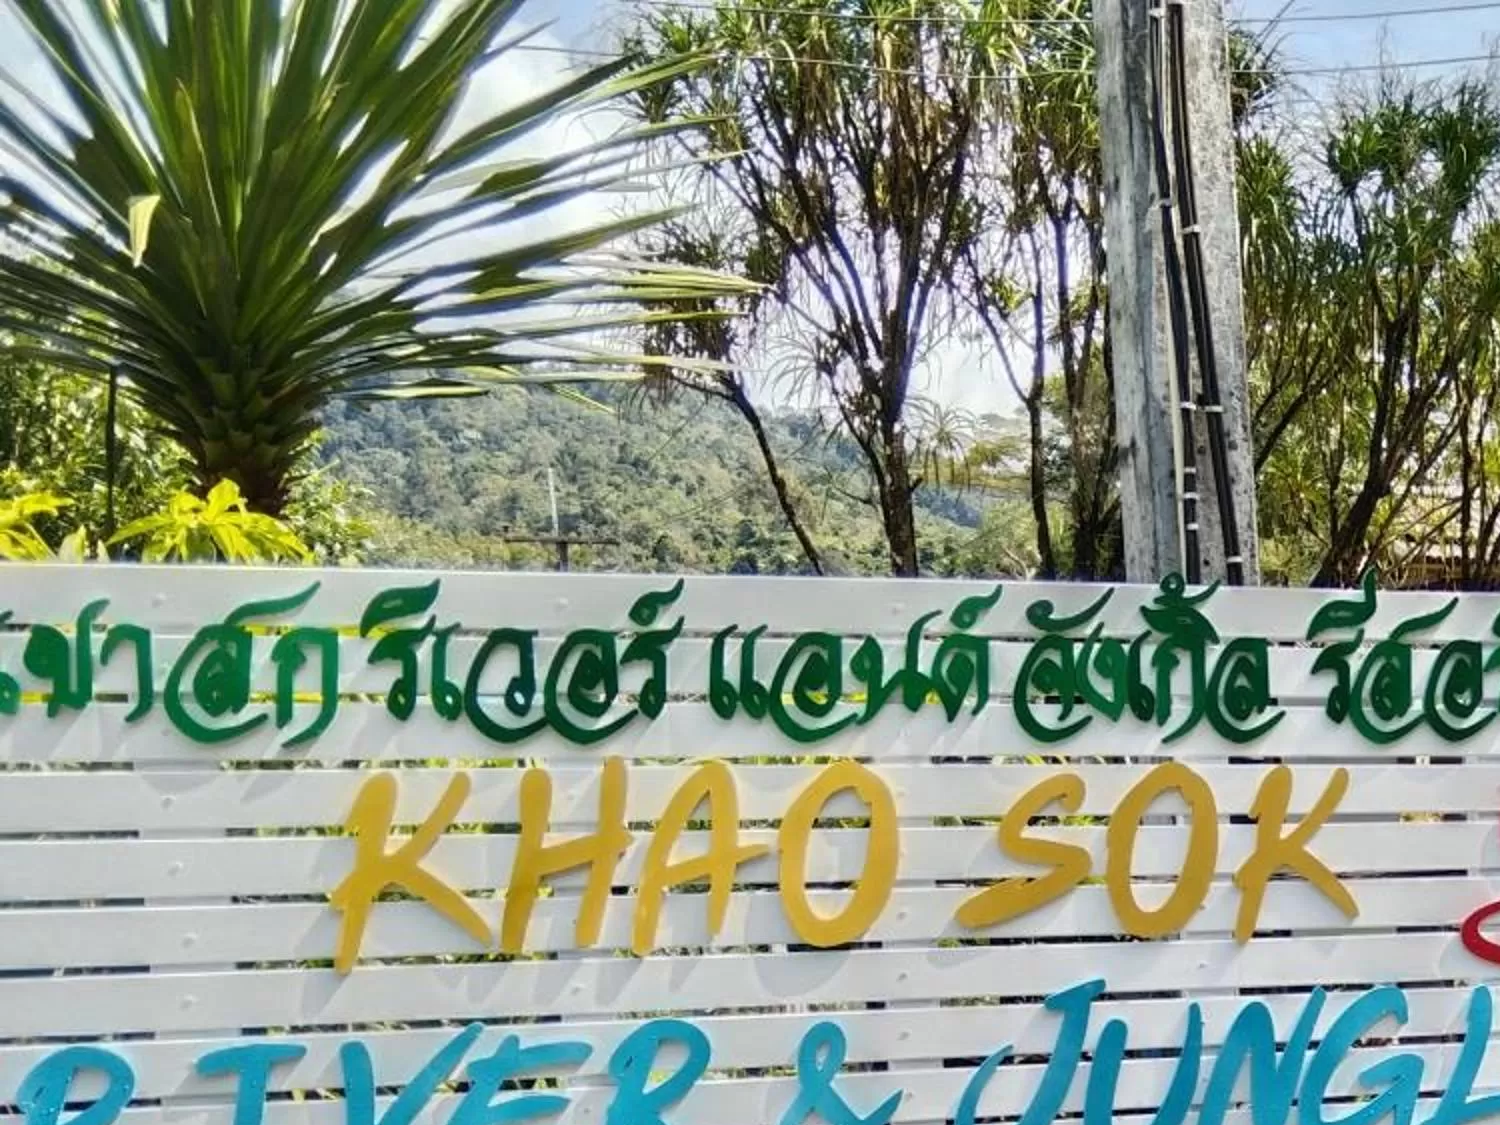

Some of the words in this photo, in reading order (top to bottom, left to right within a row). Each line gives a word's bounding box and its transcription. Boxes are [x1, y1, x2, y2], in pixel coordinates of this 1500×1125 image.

[709, 584, 1003, 742] แอนด์
[329, 756, 898, 976] KHAO
[955, 761, 1359, 944] SOK
